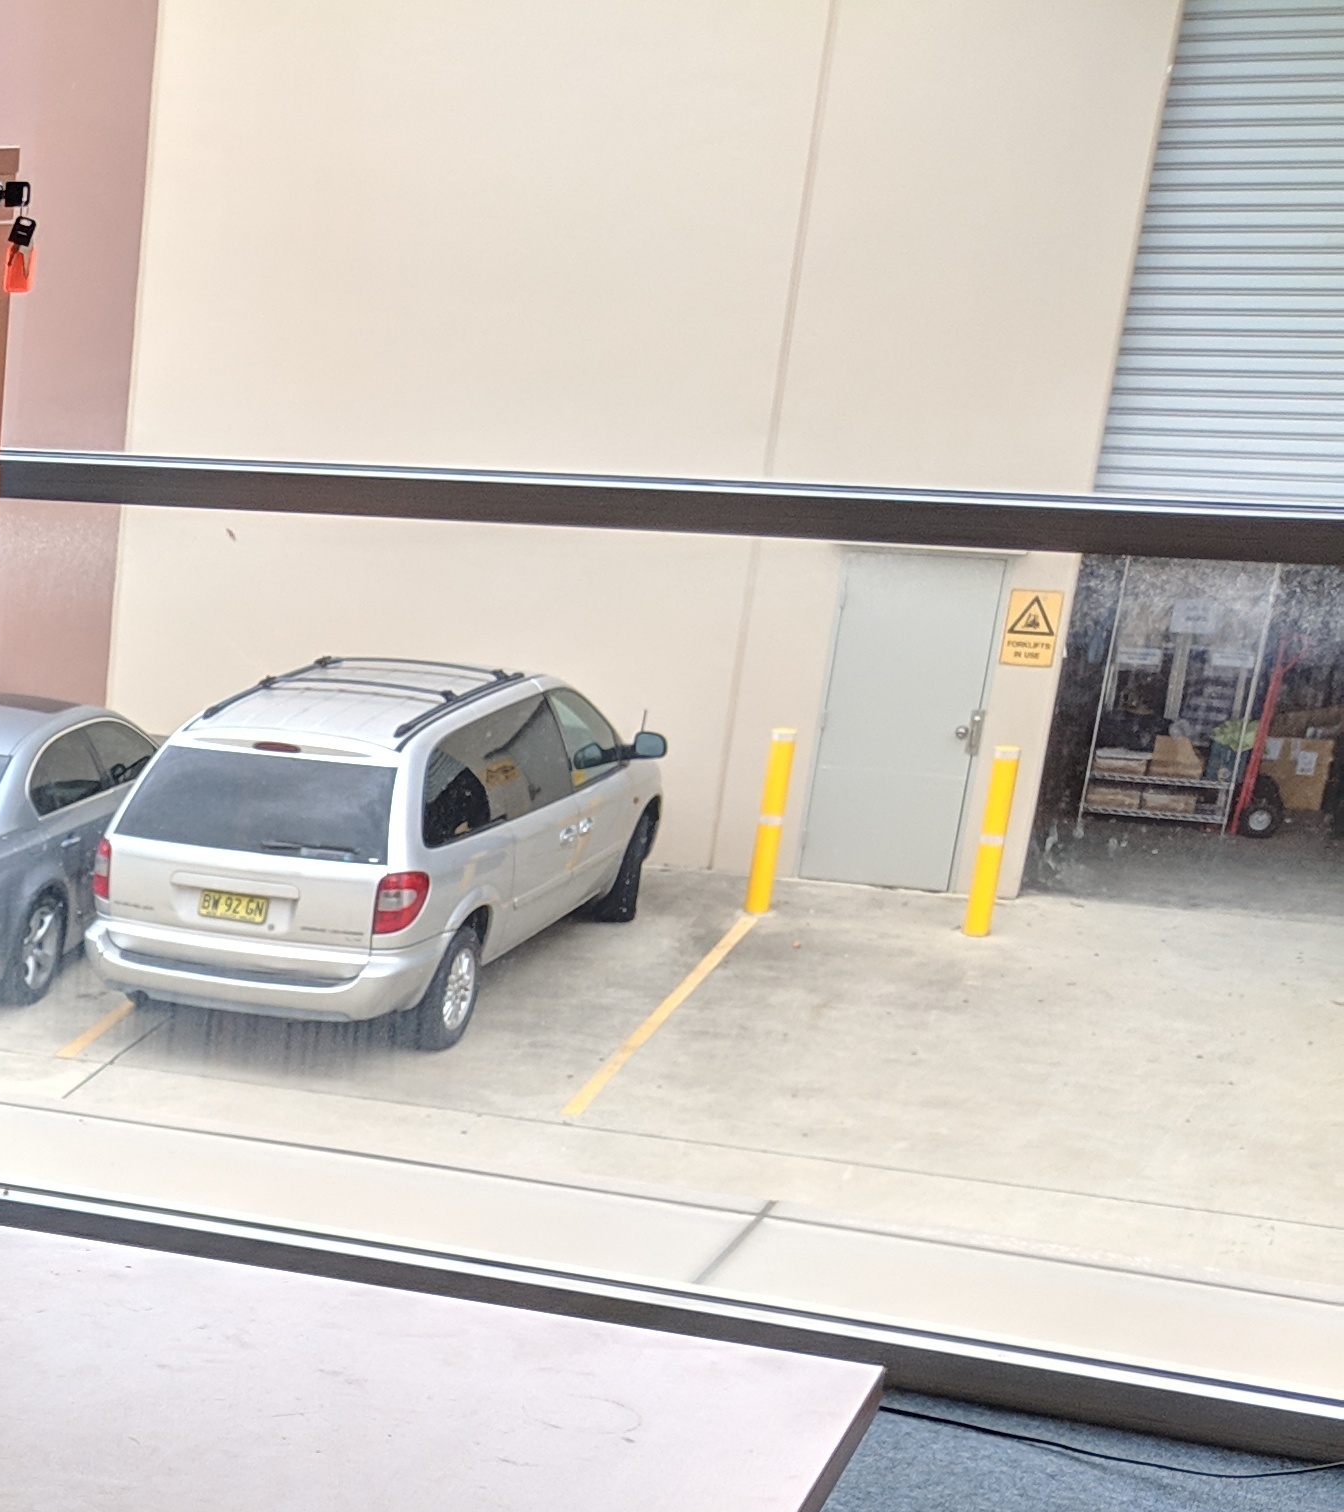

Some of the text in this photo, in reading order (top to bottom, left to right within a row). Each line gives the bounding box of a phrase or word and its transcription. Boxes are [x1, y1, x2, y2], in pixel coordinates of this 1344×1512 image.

[1006, 640, 1052, 650] FORKLIFTS
[1023, 652, 1040, 660] USE
[202, 893, 222, 911] BW
[224, 896, 242, 914] 92
[245, 897, 265, 917] GN
